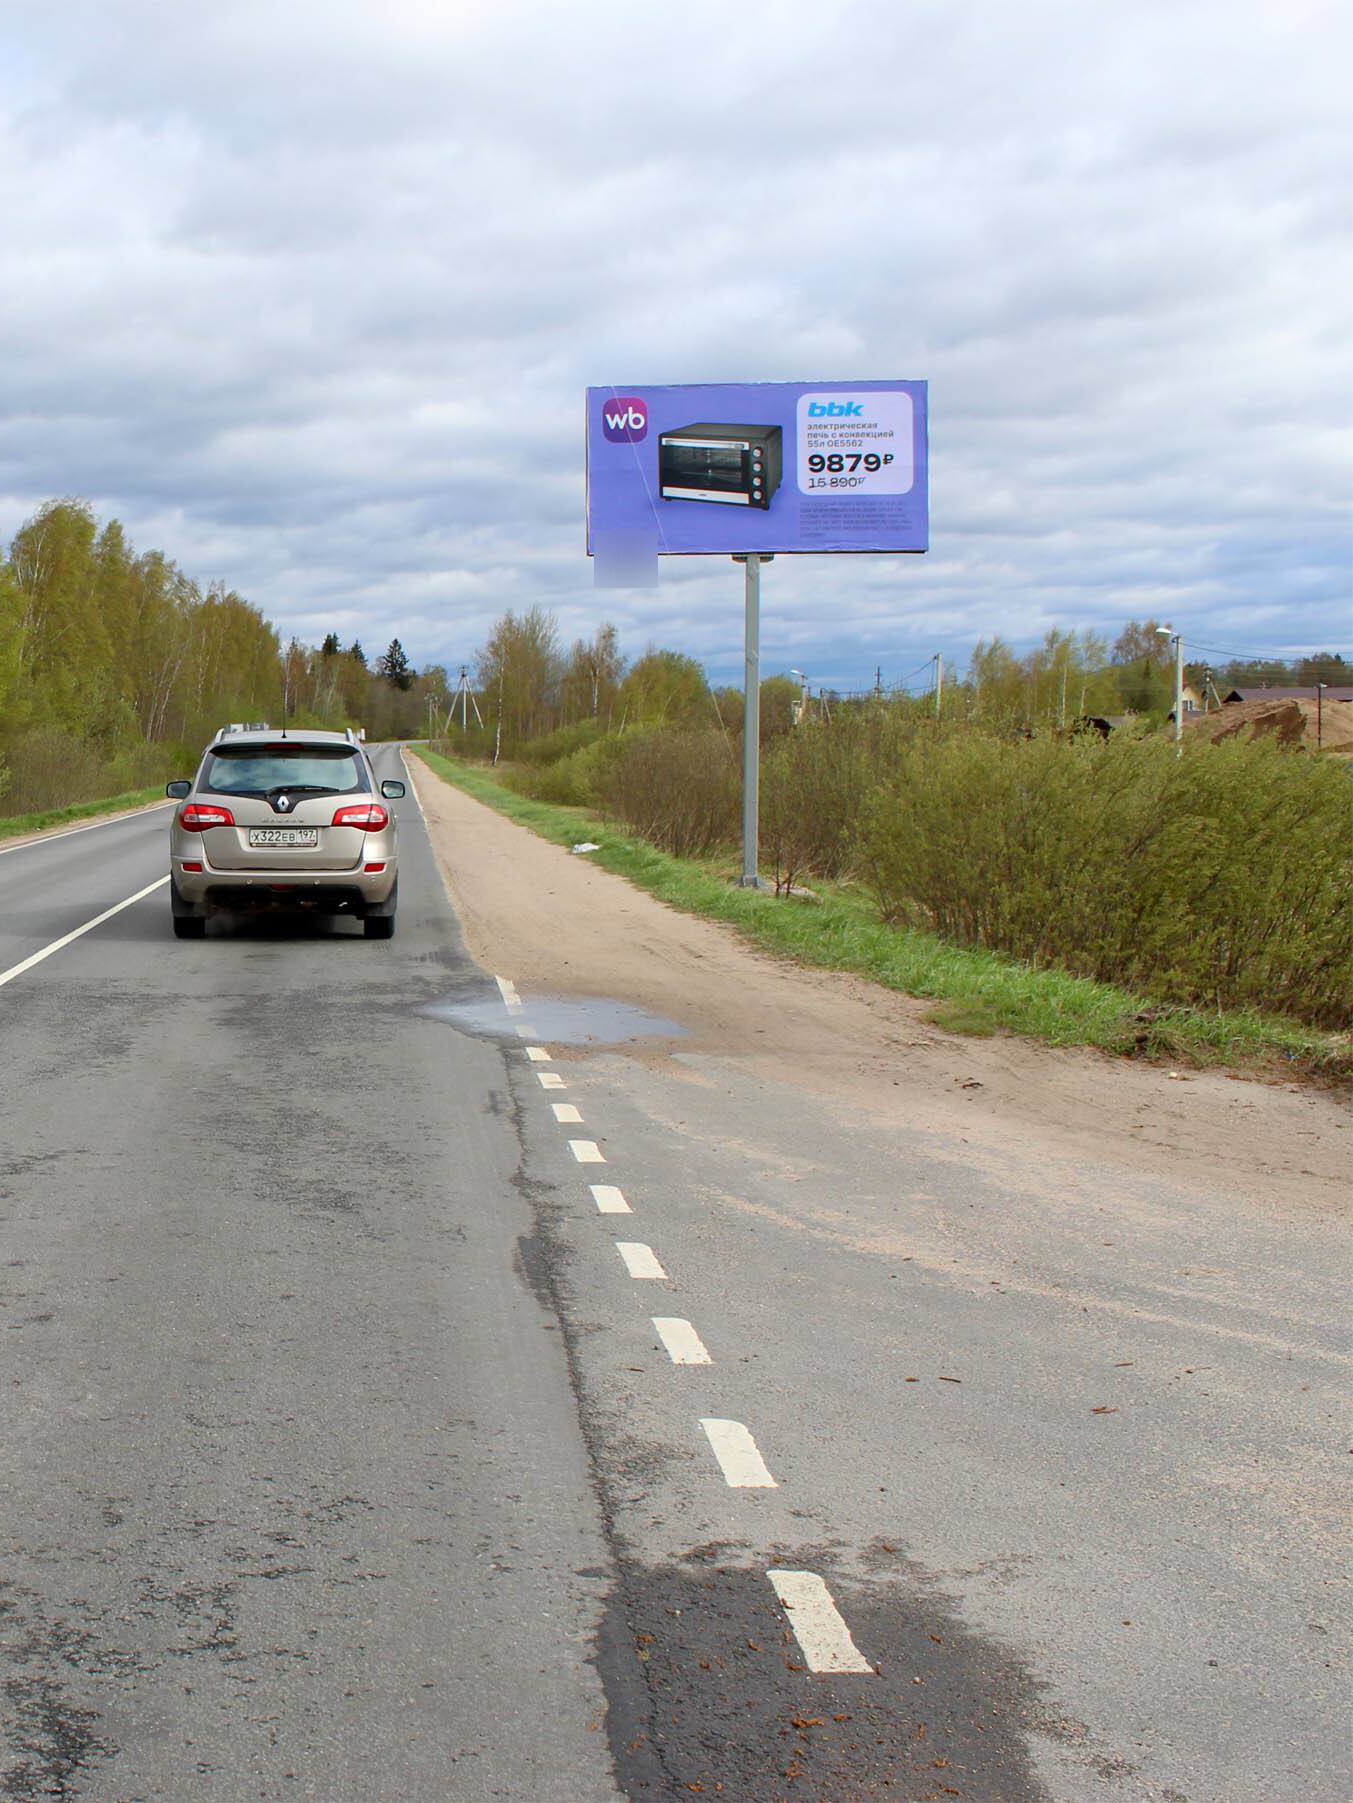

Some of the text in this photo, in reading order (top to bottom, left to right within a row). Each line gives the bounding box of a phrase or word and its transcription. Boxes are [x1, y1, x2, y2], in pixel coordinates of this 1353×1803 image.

[808, 401, 864, 416] bbk
[605, 406, 645, 430] wb
[807, 423, 878, 431] электрическая
[839, 430, 894, 440] конвекцией
[298, 830, 314, 839] 197
